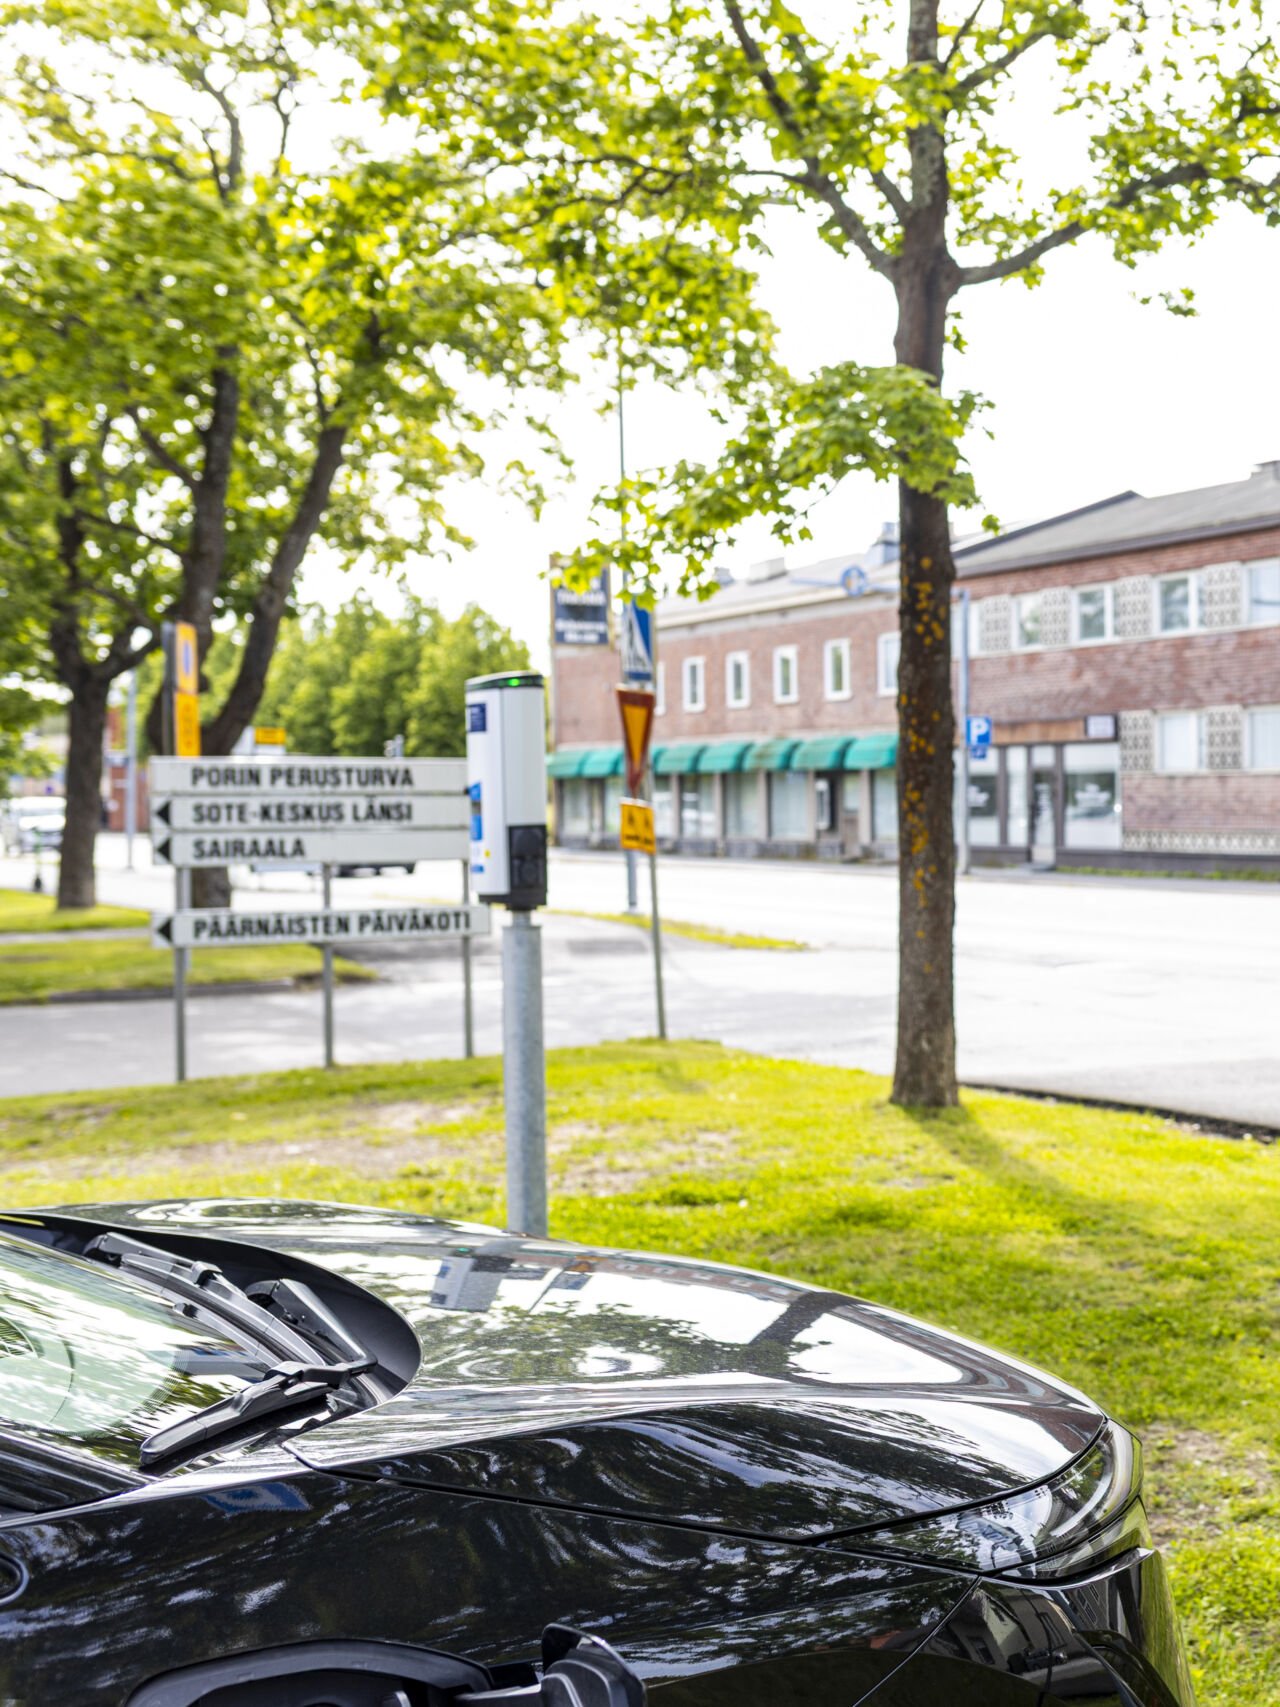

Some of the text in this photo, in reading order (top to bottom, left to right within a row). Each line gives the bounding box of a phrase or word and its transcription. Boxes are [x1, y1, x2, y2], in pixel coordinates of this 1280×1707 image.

[970, 718, 989, 745] P
[191, 766, 414, 788] PORIN PERUSTURVA
[193, 796, 413, 824] SOTE-KESKUS LÄNSI
[193, 839, 307, 860] SAIRAALA
[193, 909, 471, 939] PÄÄRNÄISTEN PÄIVÄKOTI
